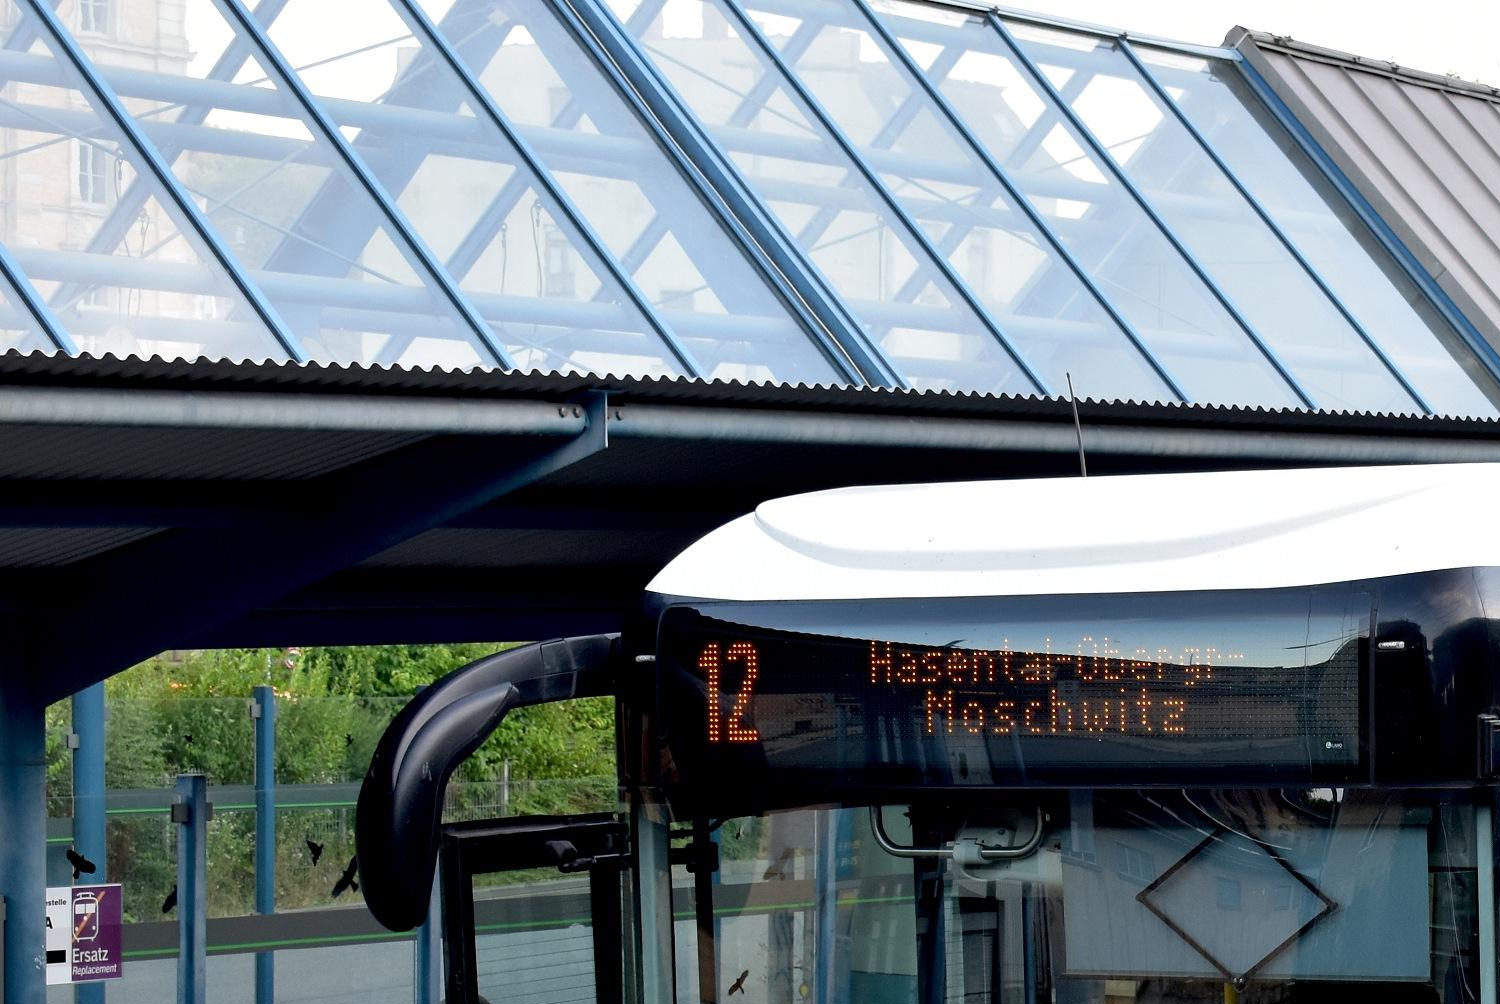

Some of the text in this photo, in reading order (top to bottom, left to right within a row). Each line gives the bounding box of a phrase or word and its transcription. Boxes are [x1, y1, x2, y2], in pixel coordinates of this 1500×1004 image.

[699, 643, 757, 741] 12
[928, 688, 1184, 732] Moschwitz
[72, 947, 109, 963] Ersatz
[72, 963, 117, 977] Replacement
